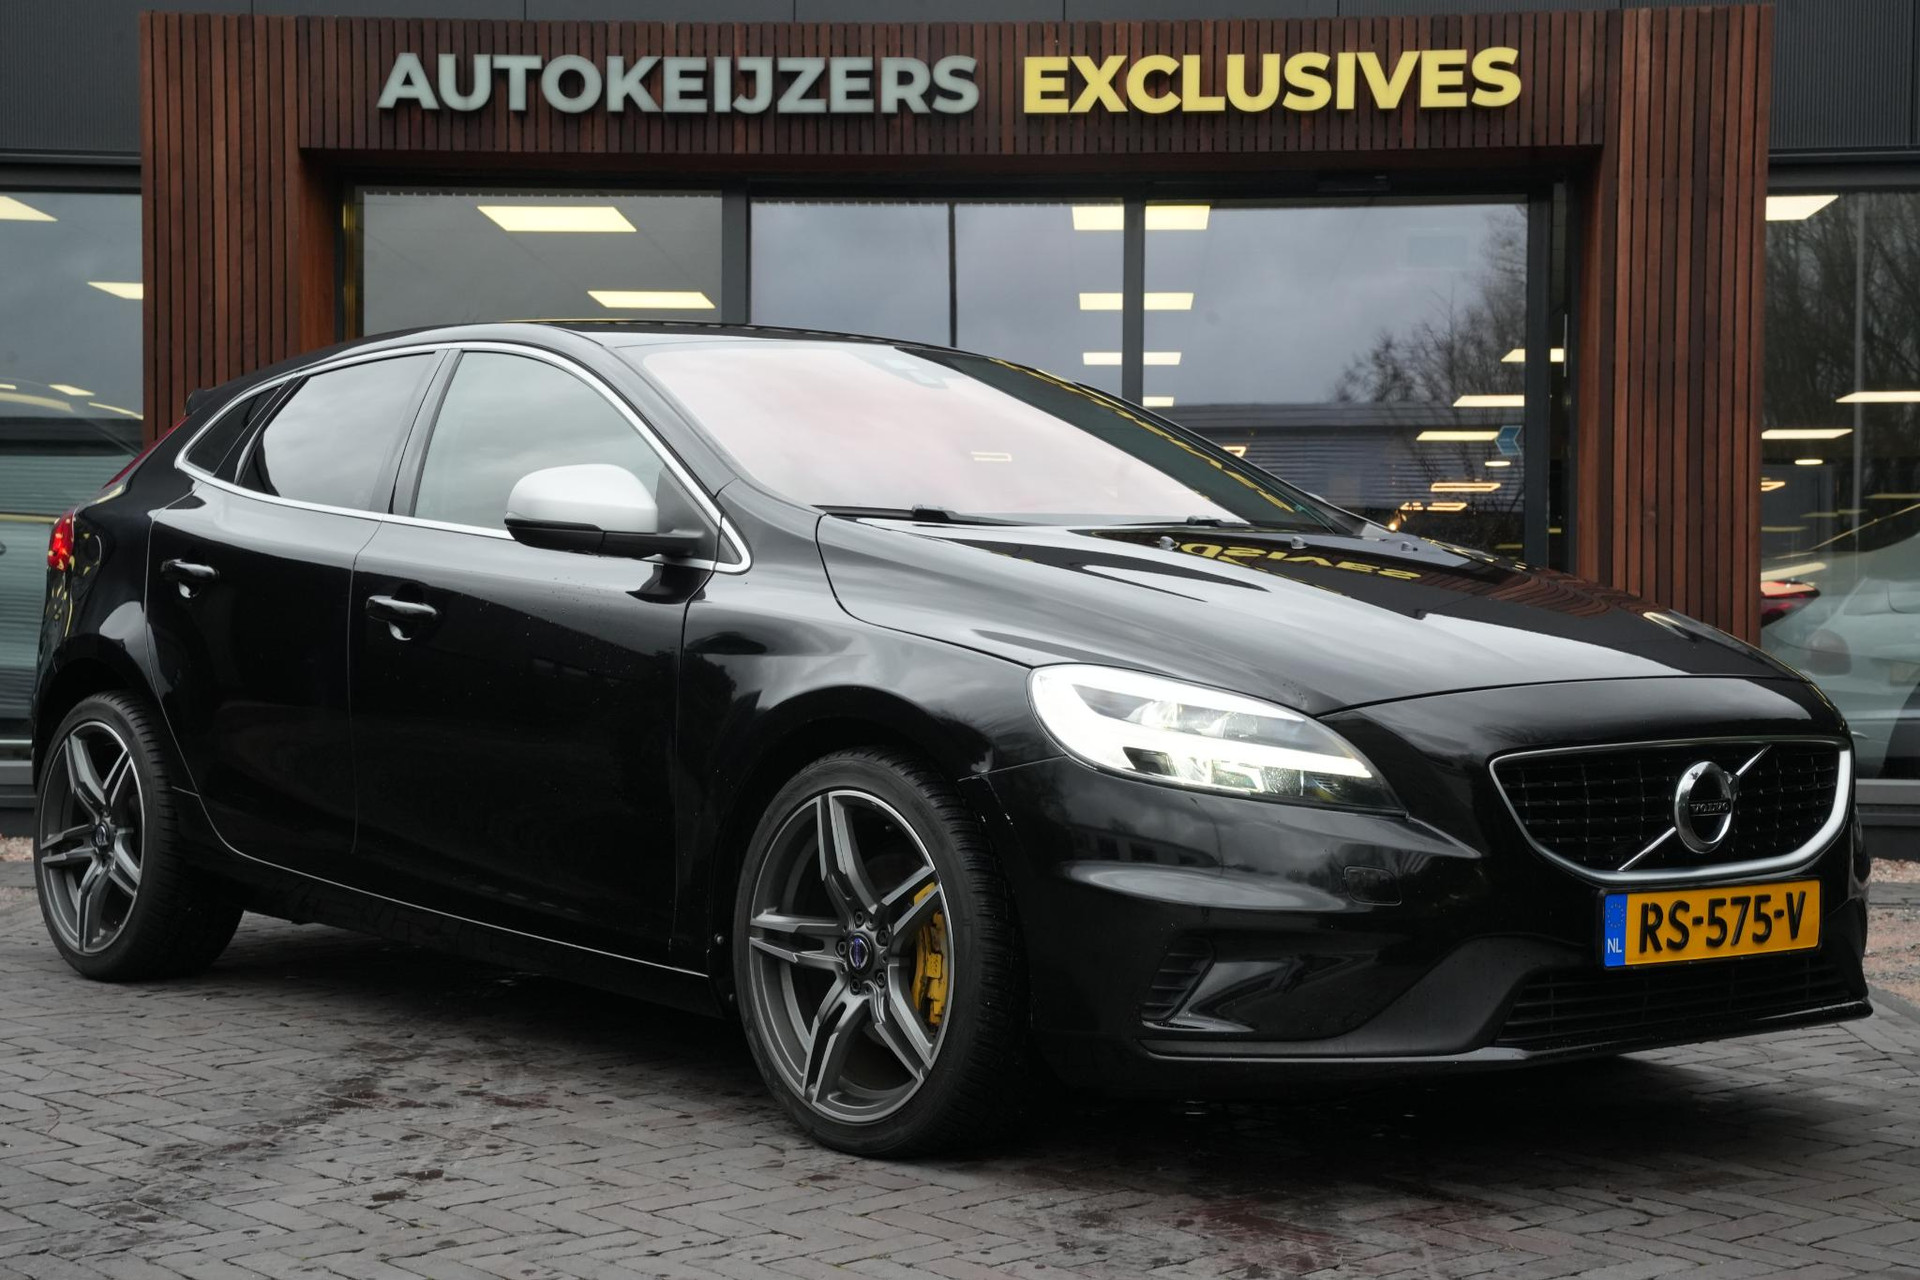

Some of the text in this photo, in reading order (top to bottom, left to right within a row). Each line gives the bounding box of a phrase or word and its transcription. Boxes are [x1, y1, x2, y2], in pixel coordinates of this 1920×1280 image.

[377, 47, 1522, 114] AUTOKEIJZERS EXCLUSIVES
[1607, 890, 1806, 953] NL RS-575-V
